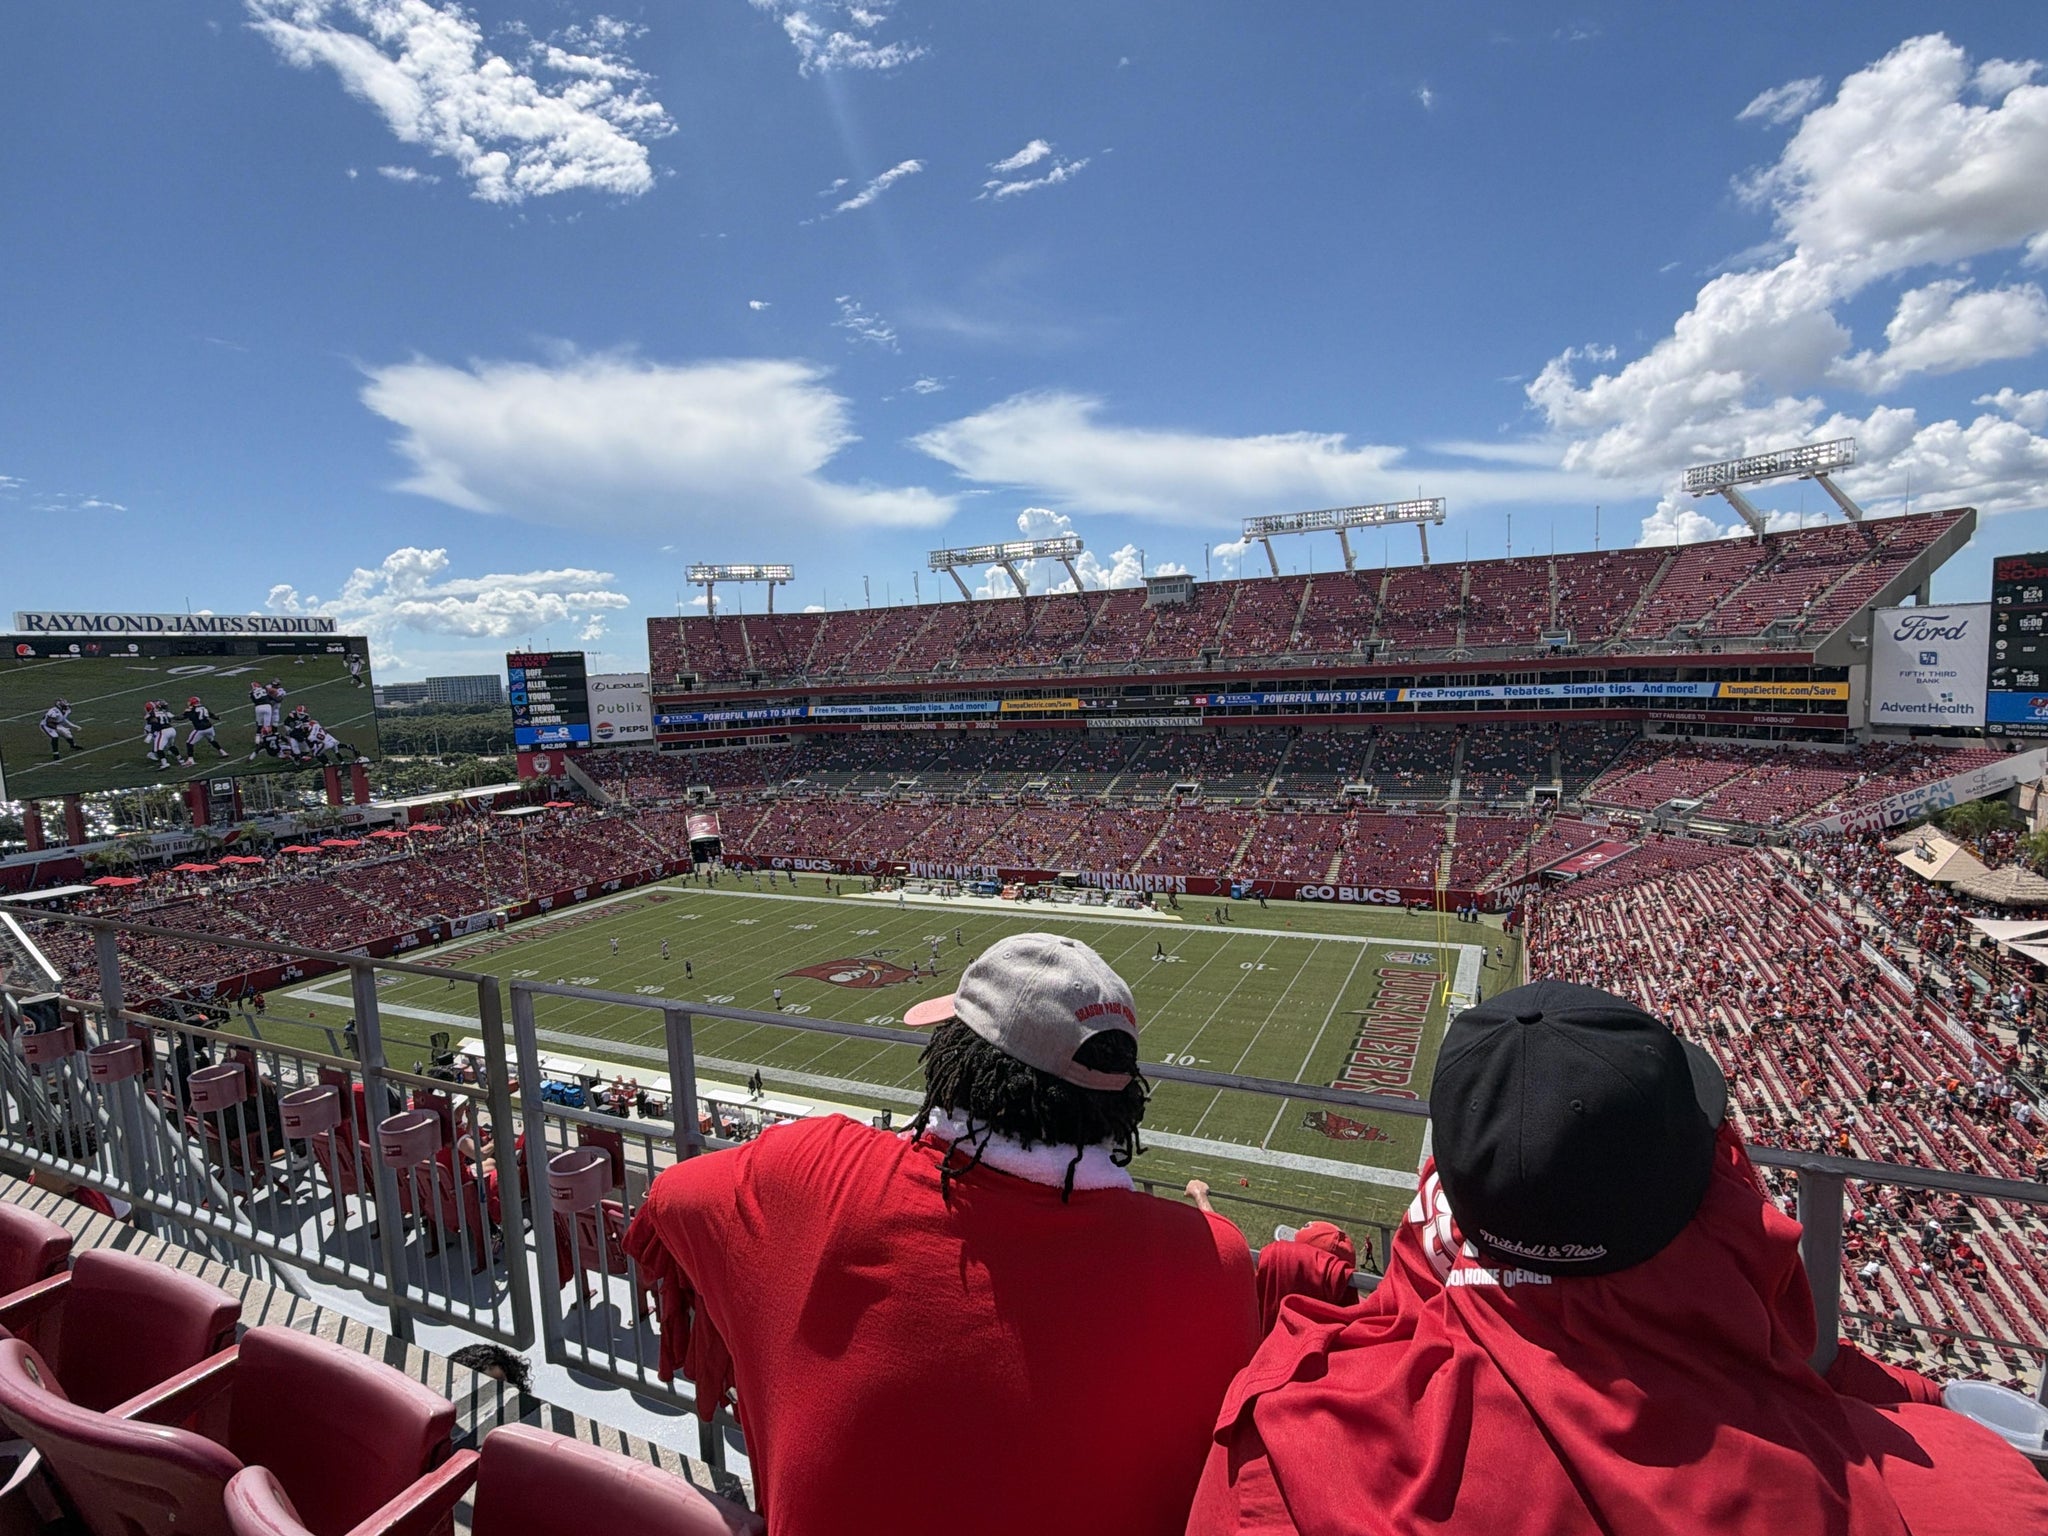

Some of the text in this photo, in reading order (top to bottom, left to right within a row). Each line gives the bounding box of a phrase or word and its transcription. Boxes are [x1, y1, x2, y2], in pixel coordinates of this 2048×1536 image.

[1998, 560, 2032, 570] NFL
[1997, 596, 2012, 604] 13
[2023, 590, 2043, 599] 0:24
[24, 614, 335, 632] RAYMOND JAMES STADIUM
[1893, 615, 1968, 641] Ford
[1998, 624, 2007, 632] 6
[2020, 618, 2043, 627] 15:00
[69, 644, 81, 653] 6
[127, 644, 139, 653] 9
[1996, 652, 2005, 660] 3
[1992, 679, 2007, 687] 14
[2016, 674, 2039, 683] 12:35
[1409, 683, 1698, 700] Free Programs. Rebates. Simple tips. And more!
[1727, 685, 1836, 696] TampaElectric.com/Save
[1263, 691, 1386, 704] POWERFUL WAYS TO SAVE
[529, 703, 555, 712] STROUD
[597, 702, 642, 715] Publix
[831, 706, 864, 714] Programs.
[902, 704, 931, 712] Simple
[932, 704, 944, 712] tips.
[966, 702, 987, 710] more!
[1006, 701, 1072, 709] TampaElectric.com/Save
[1880, 702, 1974, 714] AdventHealth
[703, 711, 744, 721] POWERFUL
[747, 709, 767, 719] WAYS
[770, 709, 779, 717] TO
[782, 707, 800, 716] SAVE
[531, 716, 561, 724] JACKSON
[1088, 718, 1201, 727] RAYMOND JAMES STADIUM
[619, 725, 649, 733] PEPSI
[900, 722, 937, 730] CHAMPIONS
[214, 782, 230, 791] 25
[1840, 781, 1953, 825] GLASSES FOR ALL
[771, 857, 831, 871] GO BUCS
[1301, 885, 1400, 904] GO BUCS
[1494, 882, 1540, 900] TAMPA
[781, 1004, 812, 1015] 50
[864, 1015, 894, 1026] 40
[1160, 1053, 1196, 1066] 10
[1480, 1229, 1607, 1258] Mitchell & Ness
[1464, 1268, 1500, 1286] HOME
